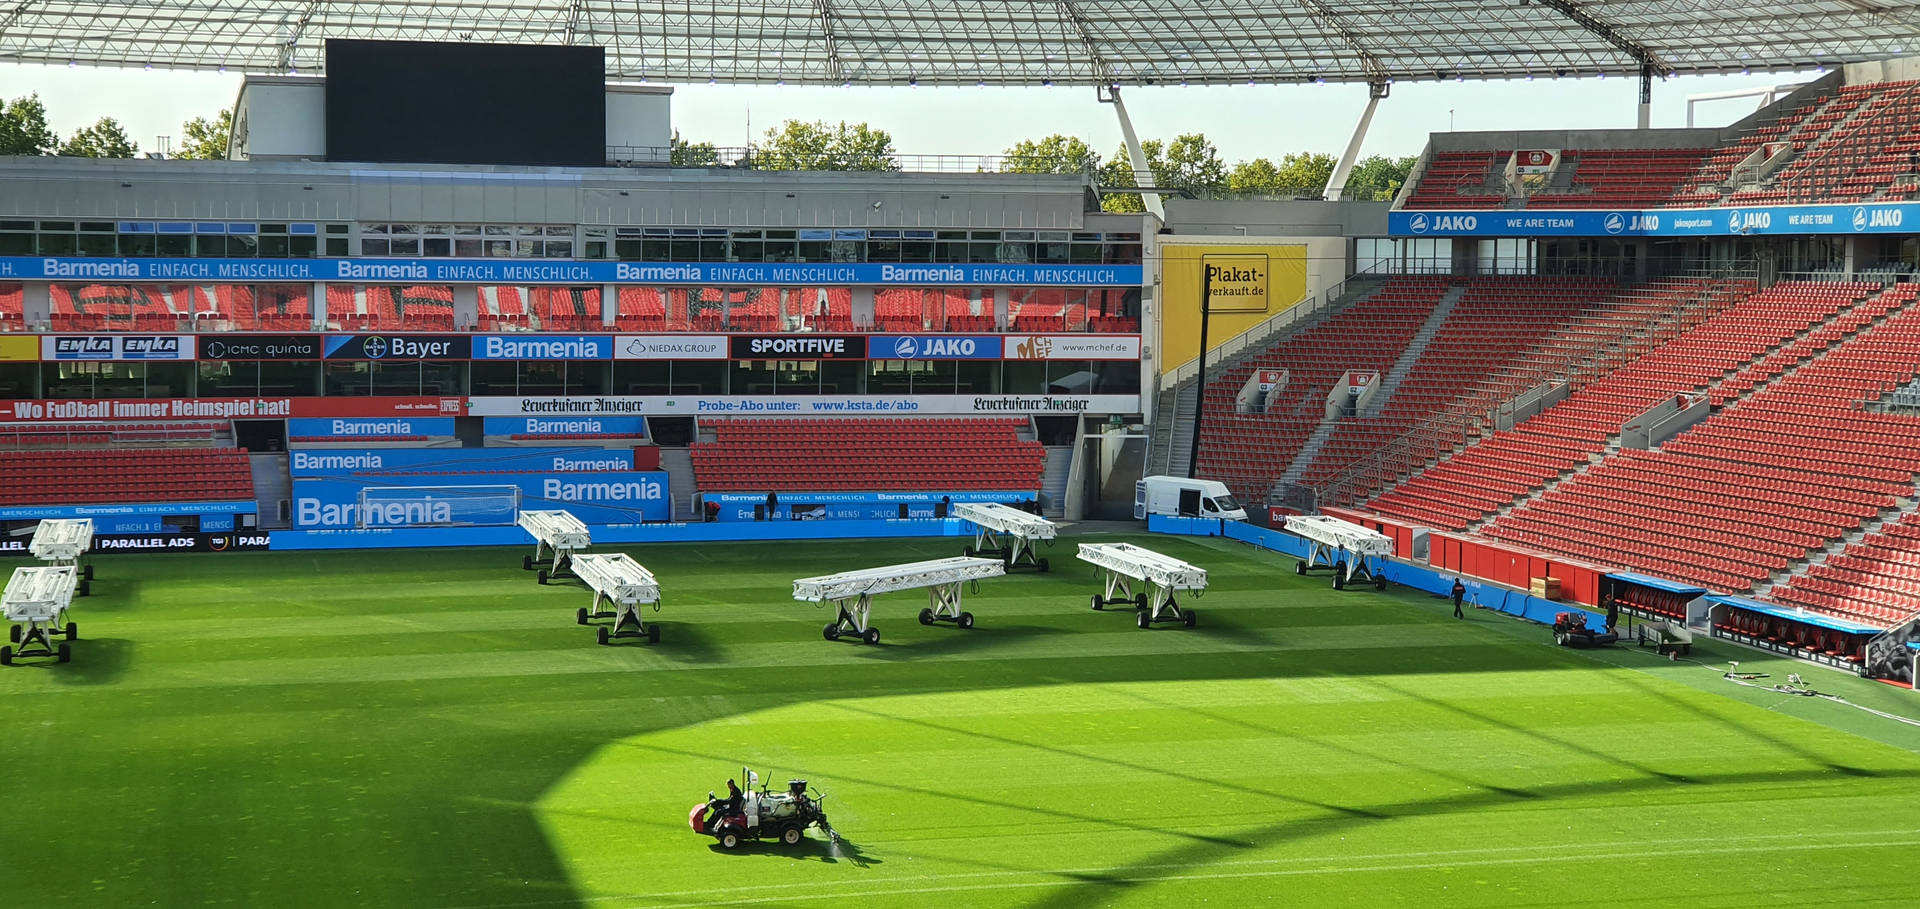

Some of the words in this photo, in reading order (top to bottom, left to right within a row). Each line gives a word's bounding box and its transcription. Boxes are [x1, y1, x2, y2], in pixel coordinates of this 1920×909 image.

[1433, 215, 1477, 231] JAKO
[1507, 219, 1522, 228] WE
[1524, 219, 1545, 228] ARE
[1547, 218, 1574, 228] TEAM
[1629, 215, 1659, 231] JAKO
[1742, 212, 1771, 228] JAKO
[1788, 215, 1800, 225] WE
[1800, 214, 1814, 225] ARE
[1815, 214, 1833, 225] TEAM
[1869, 209, 1902, 227] JAKO
[43, 259, 139, 276] Barmenia
[150, 263, 213, 277] EINFACH.
[219, 263, 313, 277] MENSCHLICH.
[338, 261, 427, 278] Barmenia
[438, 266, 498, 279] EINFACH.
[503, 266, 593, 280] MENSCHLICH.
[616, 263, 701, 280] Barmenia
[710, 268, 768, 281] EINFACH.
[773, 268, 859, 281] MENSCHLICH.
[882, 265, 964, 281] Barmenia
[973, 269, 1029, 282] EINFACH.
[1034, 269, 1118, 282] MENSCHLICH.
[1208, 266, 1264, 282] Plakat-
[58, 336, 111, 352] EMKA
[125, 336, 176, 352] EMKA
[227, 345, 259, 354] ICMC
[392, 338, 451, 359] Bayer
[487, 337, 598, 358] Barmenia
[649, 344, 683, 353] NIEDAX
[684, 344, 716, 353] GROUP
[751, 338, 845, 353] SPORTFIVE
[923, 339, 975, 356] JAKO
[1062, 343, 1127, 352] www.mchef.de
[15, 402, 42, 419] Wo
[47, 401, 110, 418] Fußball
[114, 400, 168, 417] immer
[172, 400, 255, 416] Heimspiel
[258, 399, 290, 415] hat!
[594, 398, 643, 413] Anzeiger
[698, 399, 763, 411] Probe-Abo
[766, 400, 801, 411] unter:
[812, 399, 919, 412] www.ksta.de/abo
[332, 420, 411, 435] Barmenia
[526, 418, 601, 433] Barmenia
[294, 452, 382, 469] Barmenia
[553, 457, 628, 471] Barmenia
[544, 477, 661, 500] Barmenia
[102, 538, 167, 549] PARALLEL
[168, 537, 195, 548] ADS
